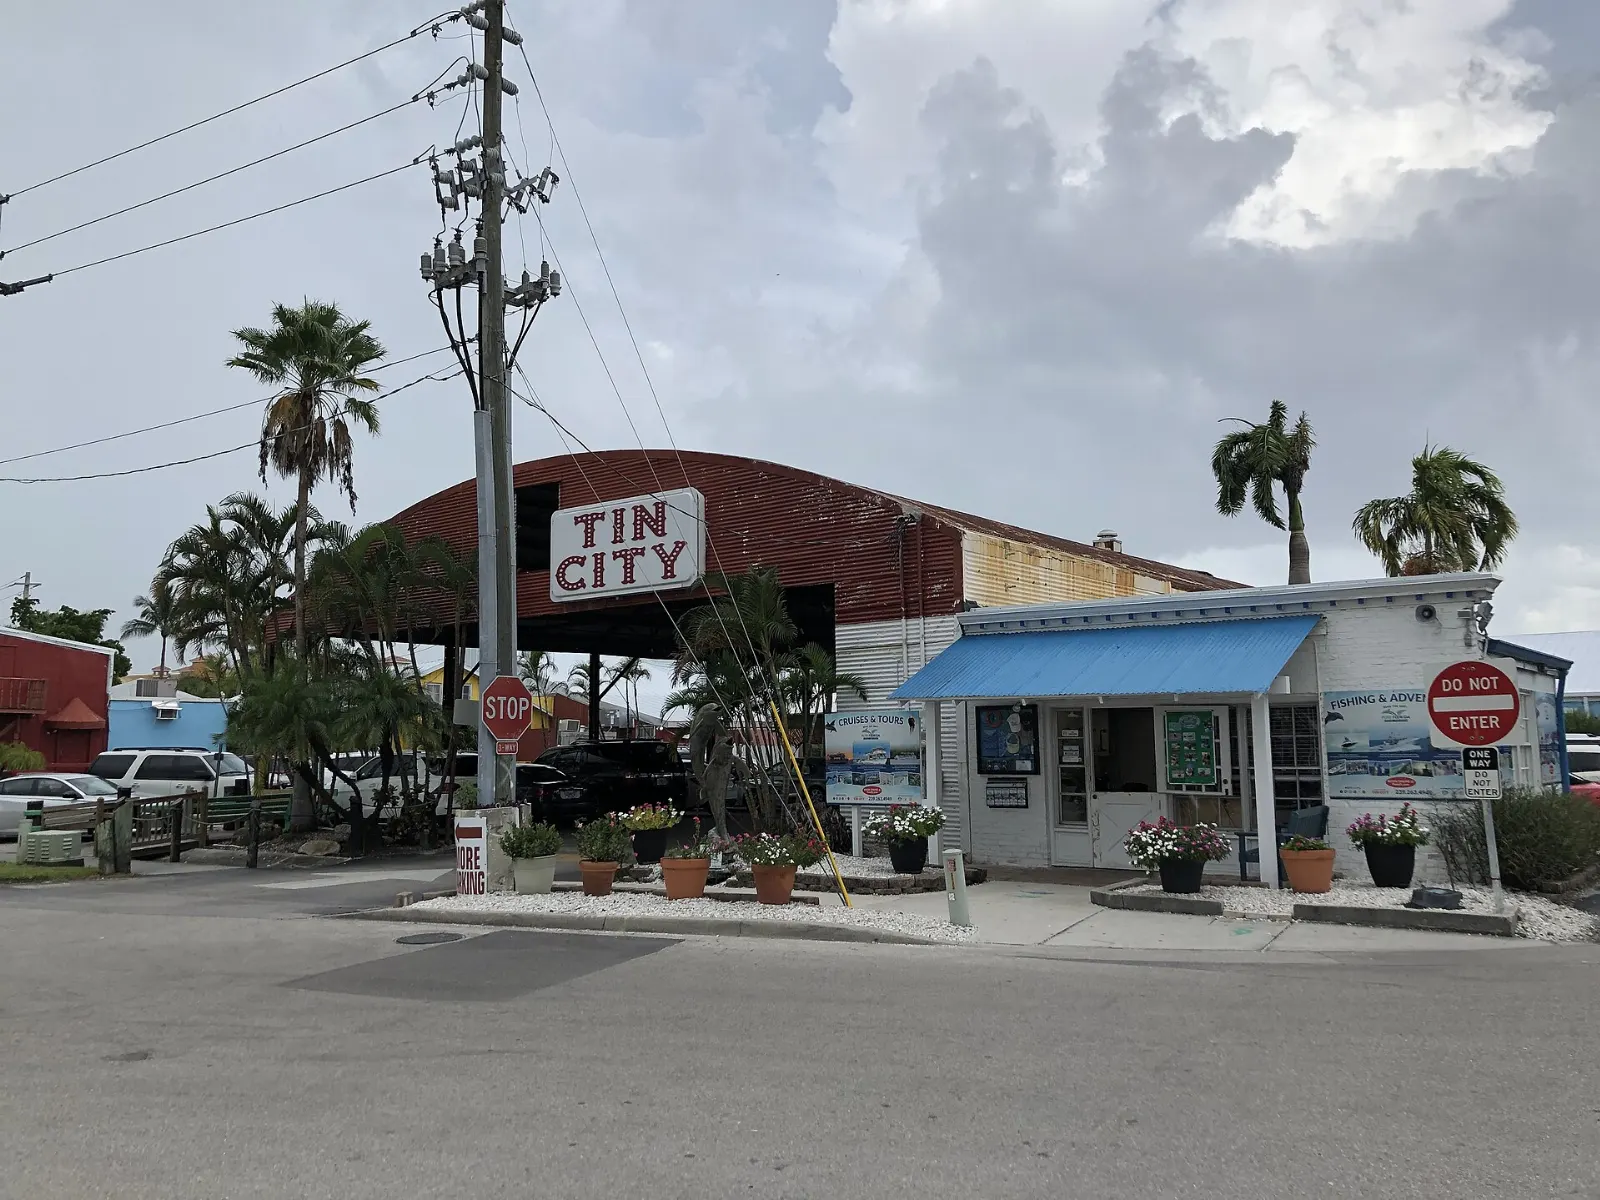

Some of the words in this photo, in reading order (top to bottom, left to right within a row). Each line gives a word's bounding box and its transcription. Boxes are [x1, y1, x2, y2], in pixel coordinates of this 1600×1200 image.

[573, 501, 668, 548] TIN
[555, 540, 687, 591] CITY
[1441, 678, 1462, 692] DO
[1469, 676, 1499, 691] NOT
[485, 696, 530, 720] STOP
[1330, 694, 1376, 710] FISHING
[1378, 694, 1387, 703] &
[838, 715, 869, 727] CRUISES
[870, 715, 876, 723] &
[877, 715, 904, 725] TOURS
[1449, 716, 1500, 730] ENTER
[497, 743, 516, 753] 3-WAY
[1469, 750, 1491, 758] ONE
[1469, 760, 1491, 768] WAY
[1472, 779, 1491, 787] NOT
[1467, 788, 1498, 796] ENTER
